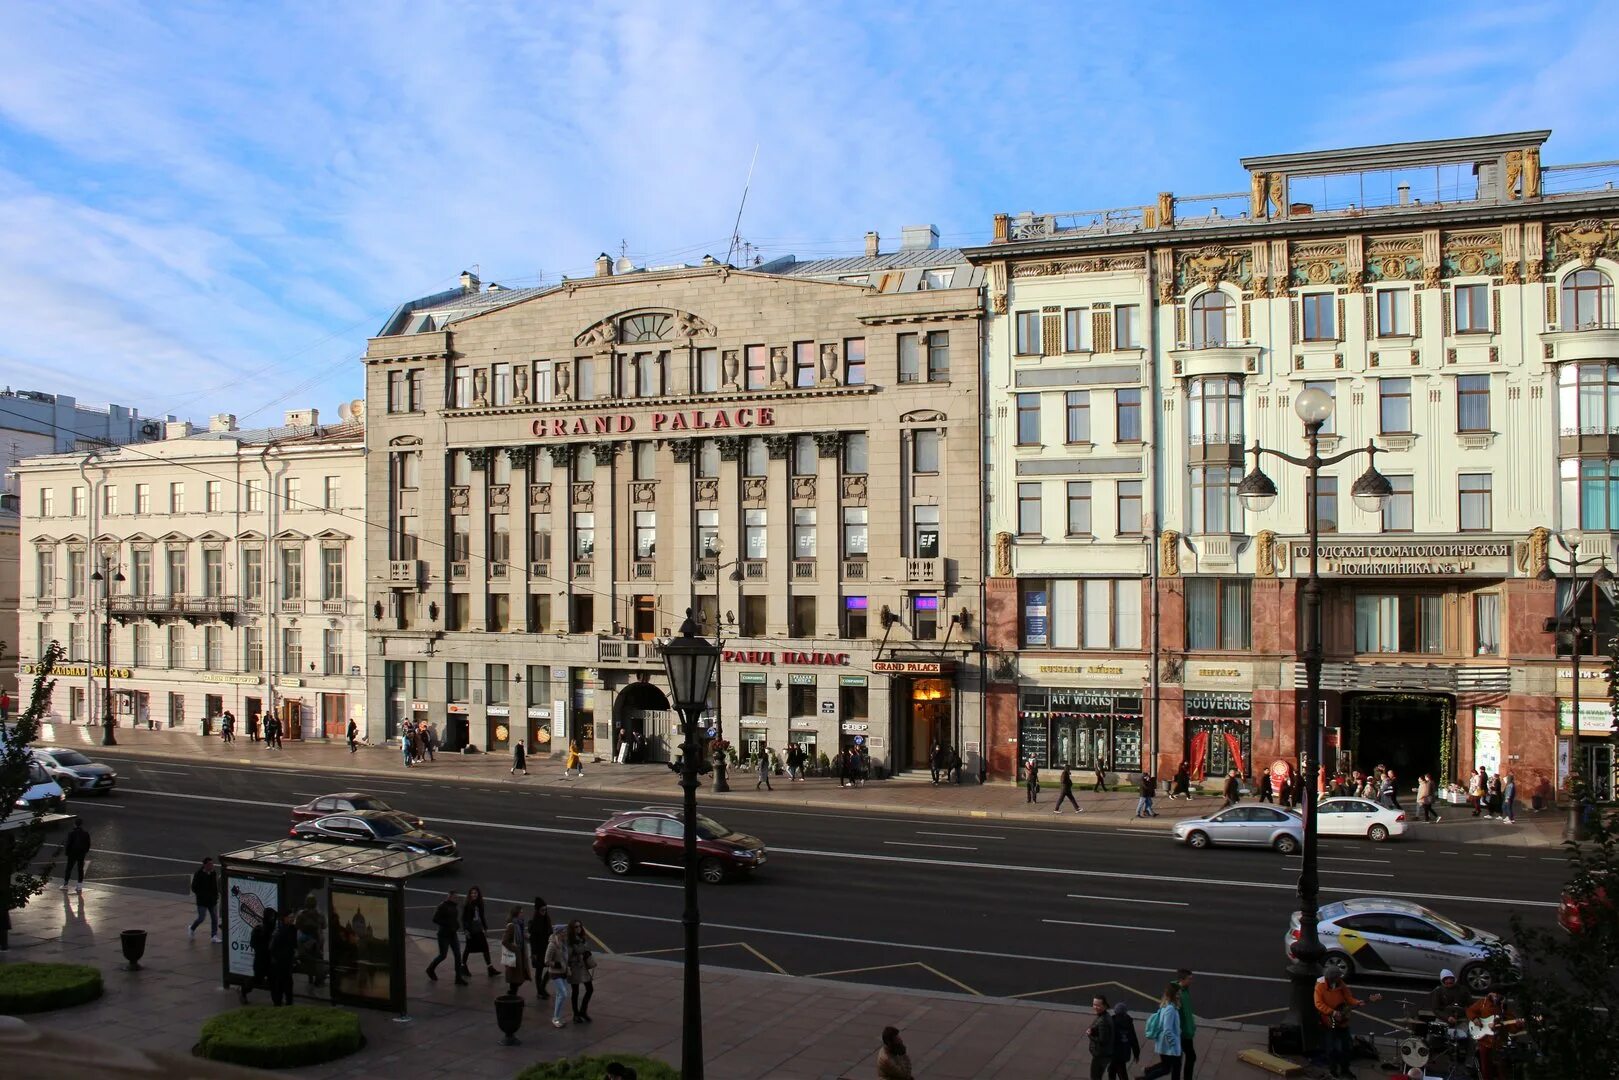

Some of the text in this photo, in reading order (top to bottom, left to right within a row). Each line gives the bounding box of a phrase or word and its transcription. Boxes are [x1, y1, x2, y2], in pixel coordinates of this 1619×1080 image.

[529, 407, 774, 437] GRAND PALACE
[920, 534, 936, 546] EF
[1294, 544, 1509, 559] ГООДСКАЯ СТОМАТОЛОГИЧЕСКАЯ
[1340, 562, 1431, 574] ПОЛИКЛИНИКА
[721, 650, 850, 666] РАНД ПАЛАС
[875, 662, 939, 672] GRAND PALACE
[1559, 670, 1591, 679] КНГИ
[1052, 694, 1111, 706] ART WORKS
[1187, 697, 1251, 710] SOUVENIRS
[842, 723, 868, 731] СЕВЕР
